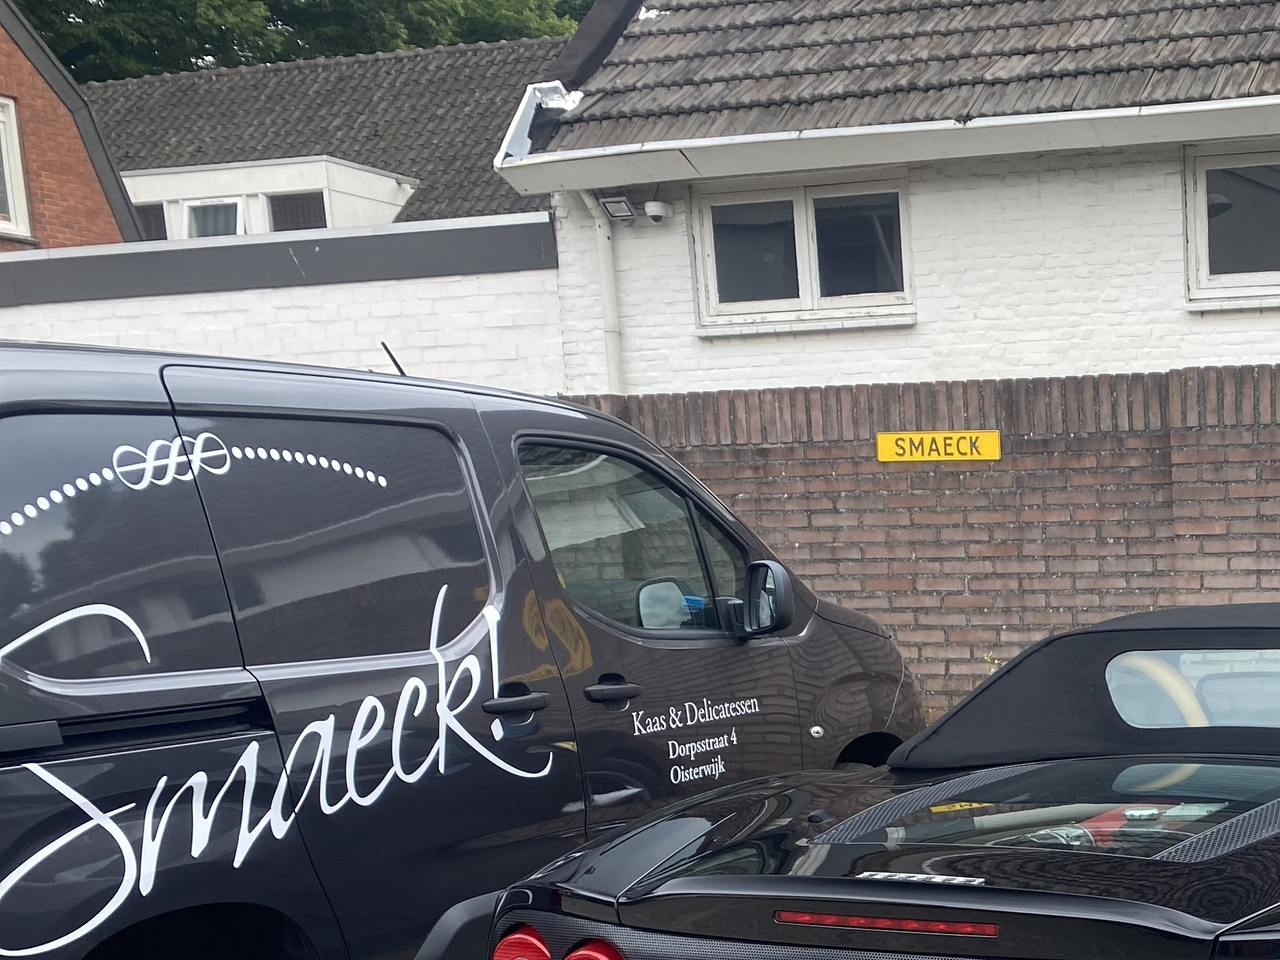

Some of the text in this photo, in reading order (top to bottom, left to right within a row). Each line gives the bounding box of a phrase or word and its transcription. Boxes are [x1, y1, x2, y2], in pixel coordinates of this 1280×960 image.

[894, 435, 982, 458] SMAECK
[631, 697, 760, 736] Kaas & Delicatessen
[667, 726, 738, 761] Dorpsstraat 4
[669, 754, 727, 784] Oisterwijk
